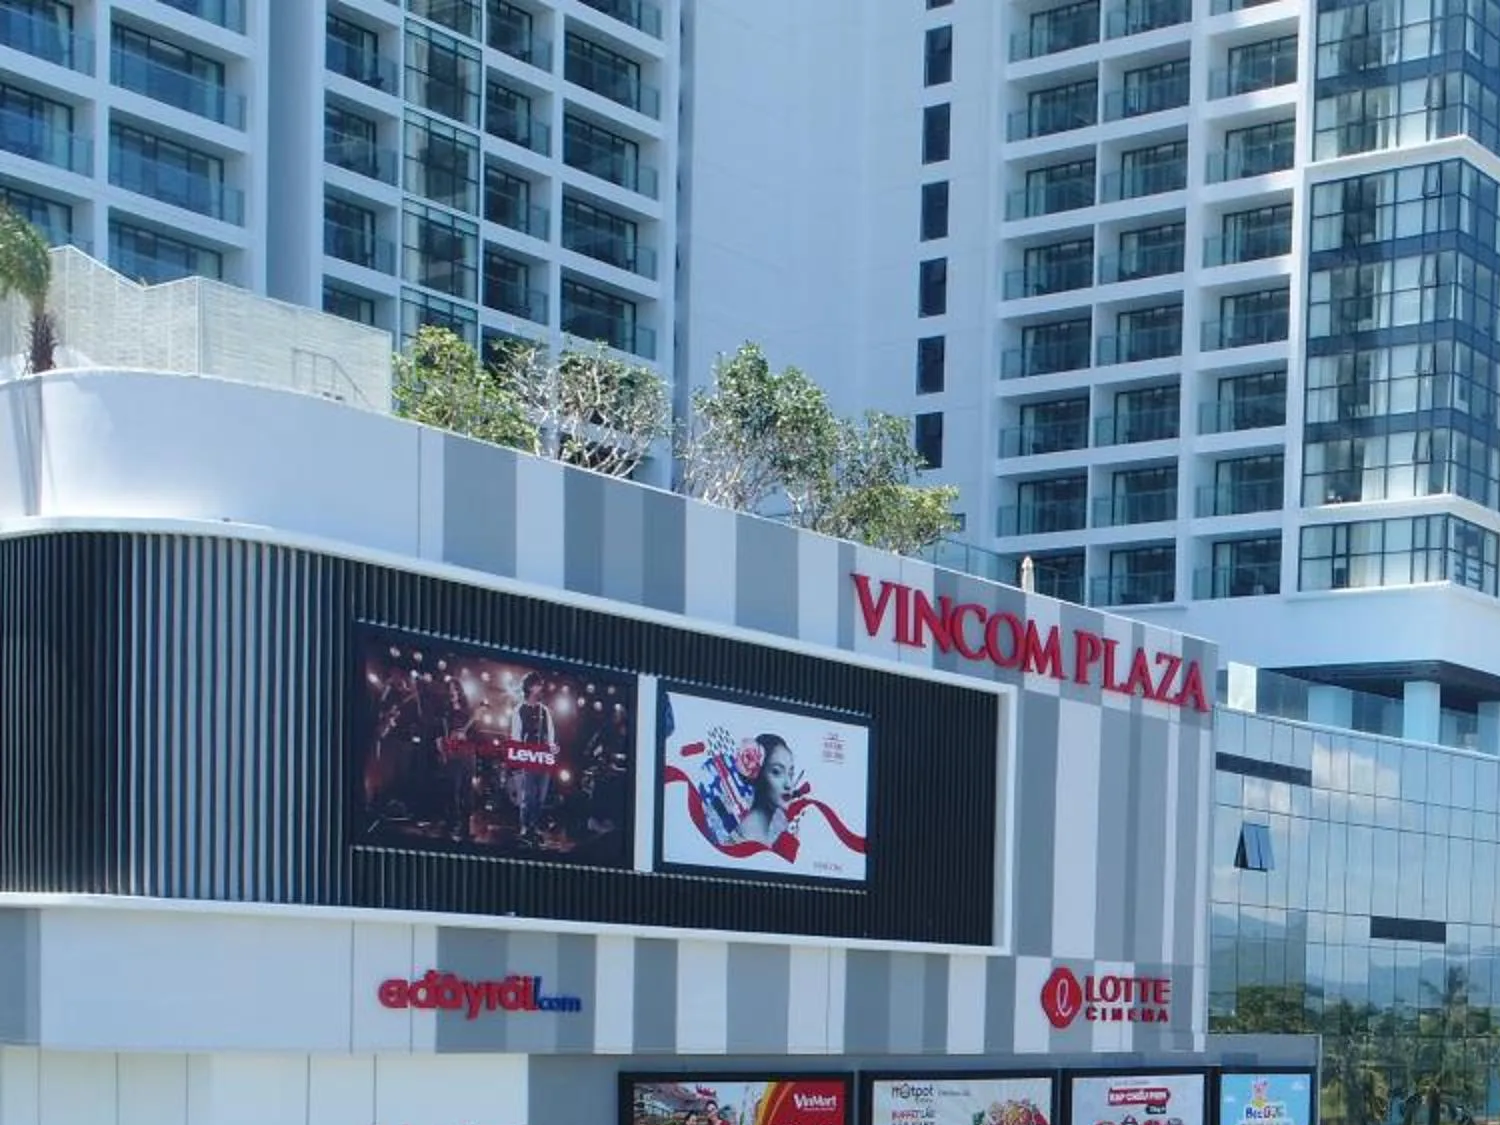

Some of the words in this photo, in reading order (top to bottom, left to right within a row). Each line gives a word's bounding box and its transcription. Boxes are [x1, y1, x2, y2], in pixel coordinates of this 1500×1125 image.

[850, 573, 1067, 680] VINCOM
[1073, 629, 1211, 712] PLAZA
[1085, 976, 1171, 1004] LOTTE
[1085, 1008, 1169, 1022] CINEMA
